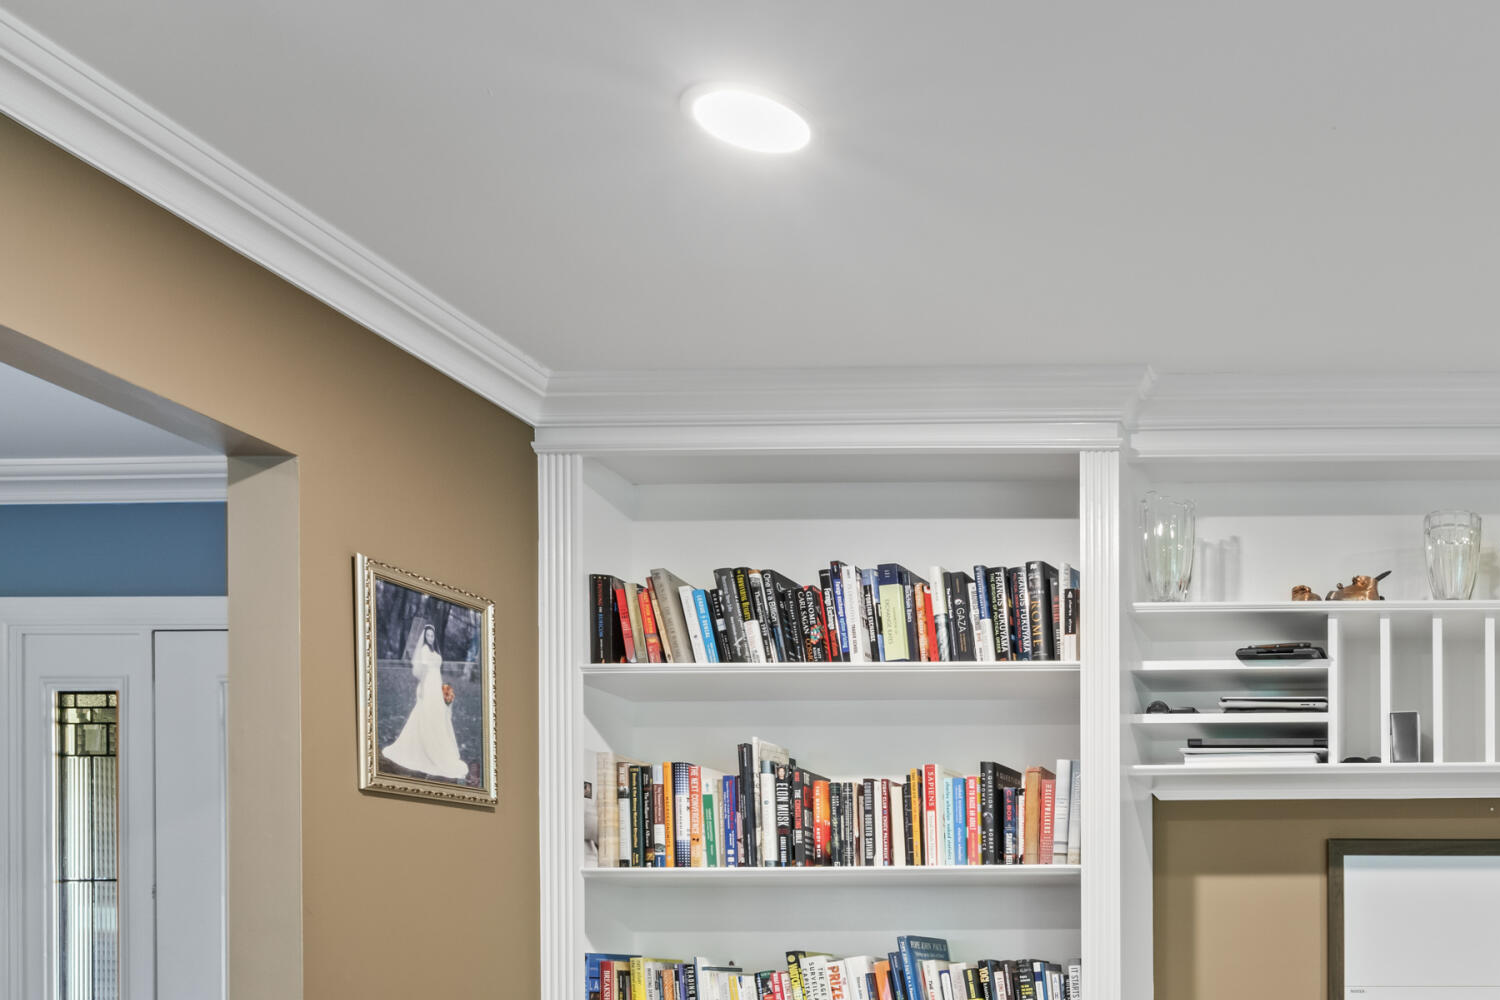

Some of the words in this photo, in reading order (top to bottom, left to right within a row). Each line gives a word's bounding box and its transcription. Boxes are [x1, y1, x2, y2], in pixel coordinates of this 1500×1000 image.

[763, 573, 771, 588] One
[769, 601, 777, 622] Billion
[798, 591, 806, 610] CARL
[824, 588, 833, 606] Foreign
[995, 572, 1006, 606] FRANCIS
[1017, 572, 1027, 606] FRANCIS
[805, 591, 816, 624] GENOME
[827, 607, 837, 630] Exchange
[956, 608, 966, 632] GAZA
[801, 611, 810, 634] SAGAN
[998, 609, 1008, 653] FUKUYAMA
[1020, 609, 1030, 653] FUKUYAMA
[1031, 600, 1043, 648] ROME
[690, 766, 698, 776] THE
[776, 783, 788, 803] ELON
[927, 771, 935, 807] SAPIENS
[777, 804, 789, 827] MUSK
[686, 966, 695, 994] TRADING
[827, 965, 844, 1000] PRIZE
[979, 967, 989, 983] YOGI
[1071, 975, 1080, 998] STARTS
